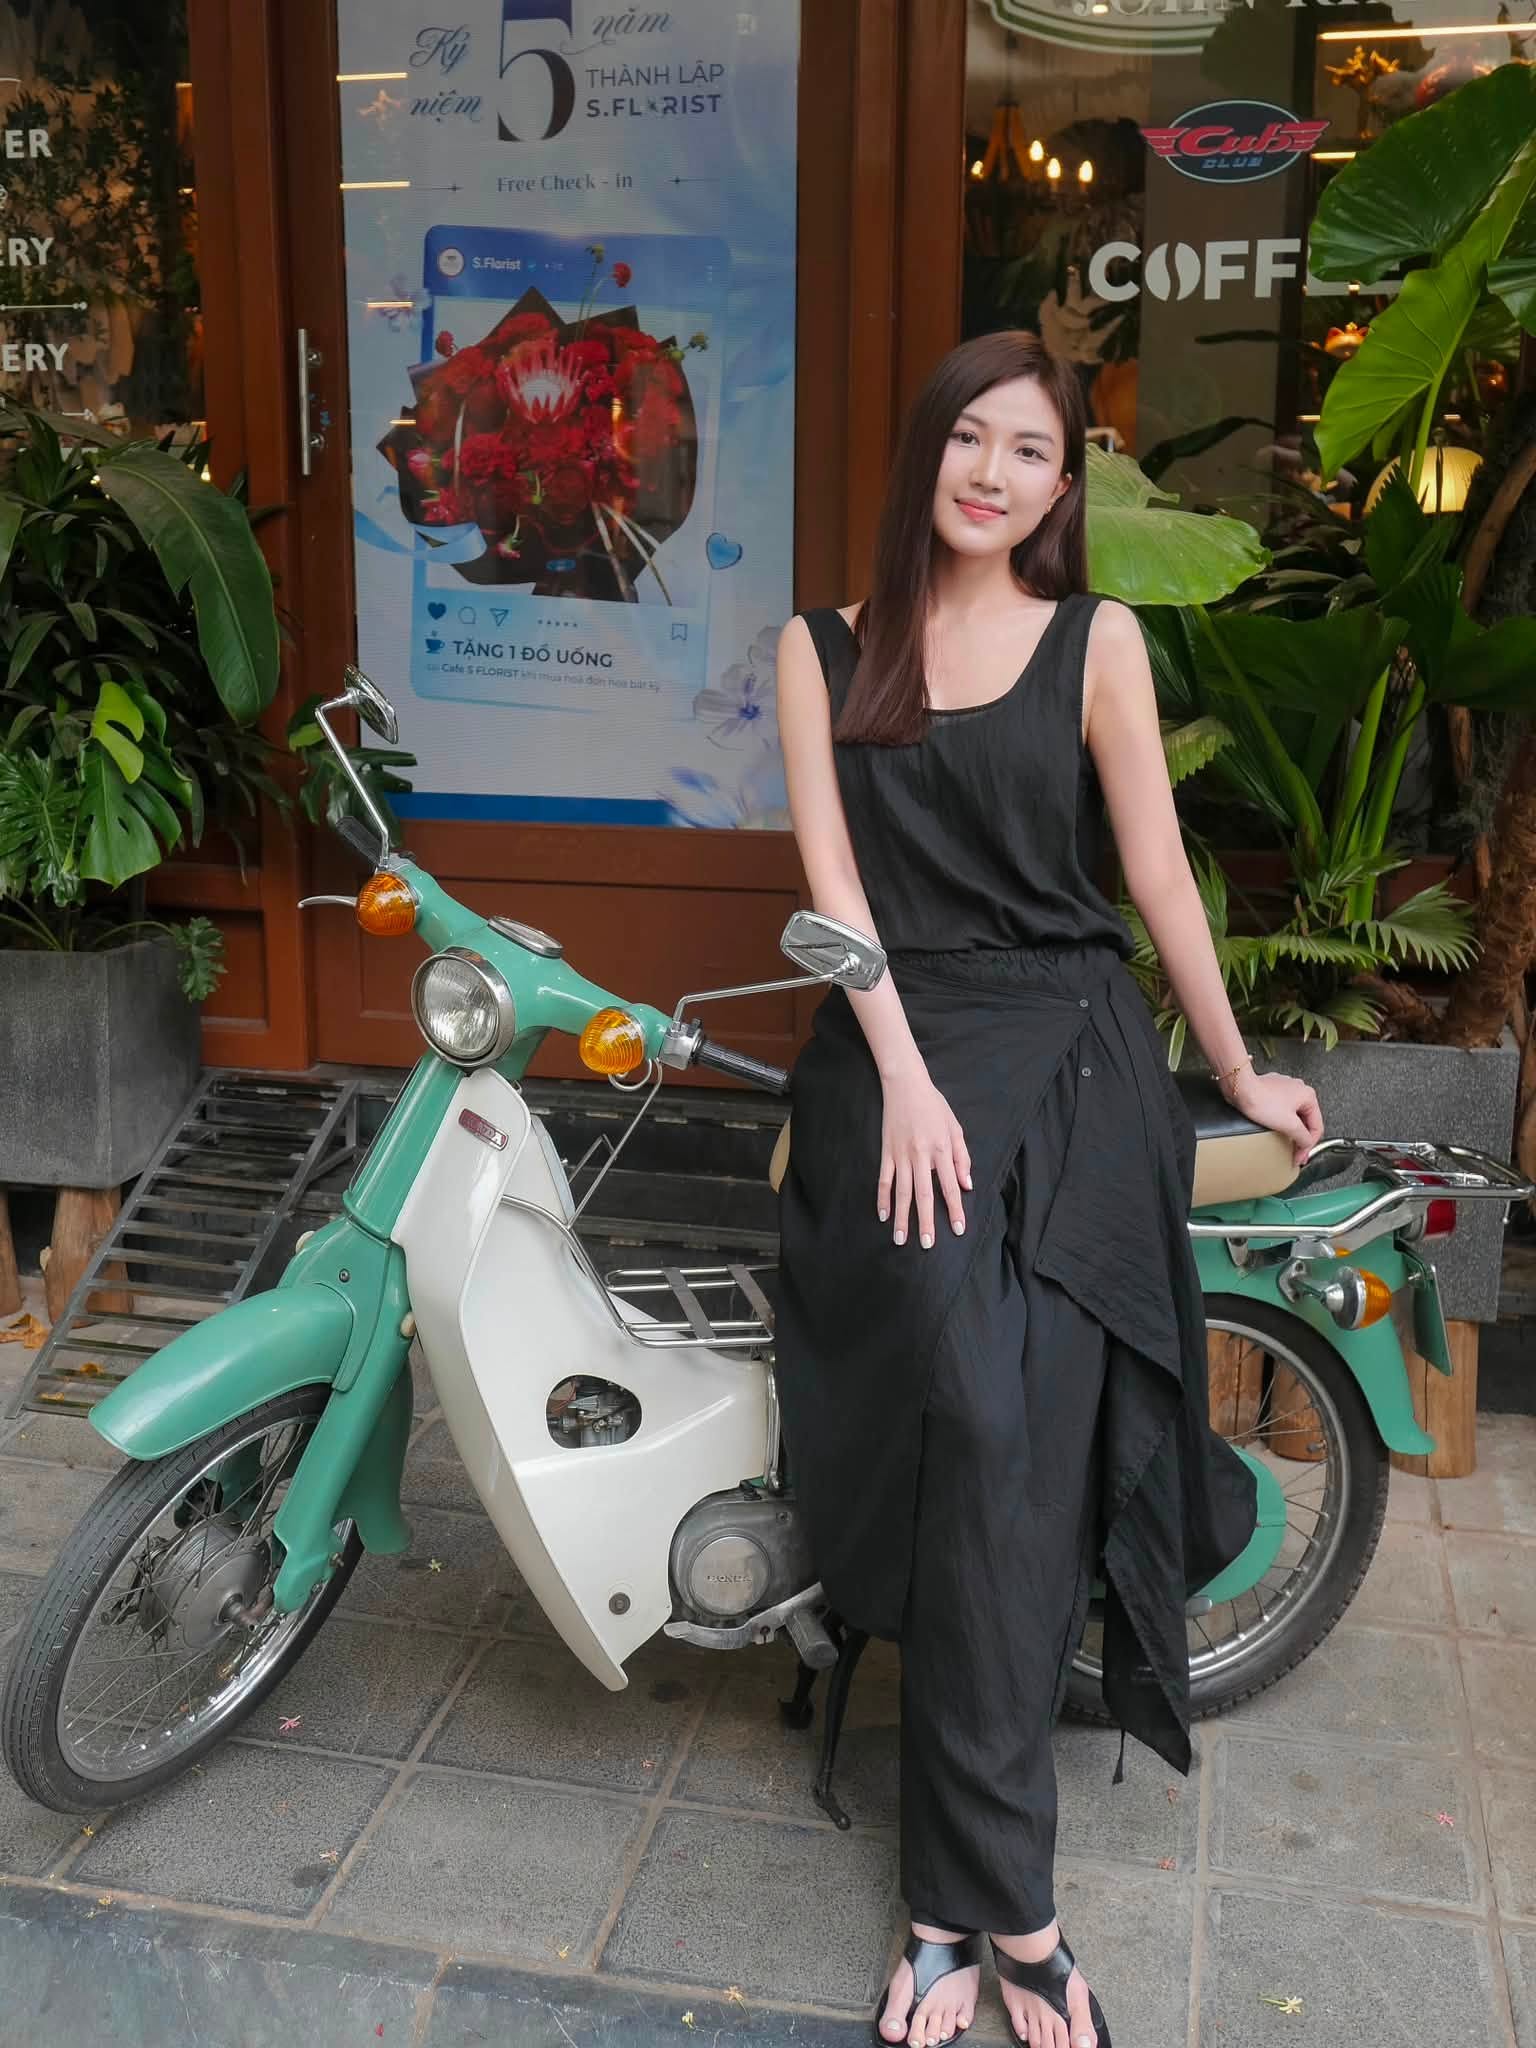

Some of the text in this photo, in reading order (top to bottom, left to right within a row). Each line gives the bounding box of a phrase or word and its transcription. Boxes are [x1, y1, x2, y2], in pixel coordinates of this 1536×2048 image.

[498, 0, 576, 142] 5
[585, 64, 670, 88] THÀNH
[1179, 122, 1294, 157] Cub
[1202, 156, 1264, 169] CLUB
[497, 176, 536, 192] Free
[541, 173, 596, 191] Check
[616, 172, 633, 188] in
[0, 237, 54, 267] RY
[1088, 238, 1402, 302] COFF
[509, 645, 516, 659] 1
[476, 666, 520, 680] FLORIST
